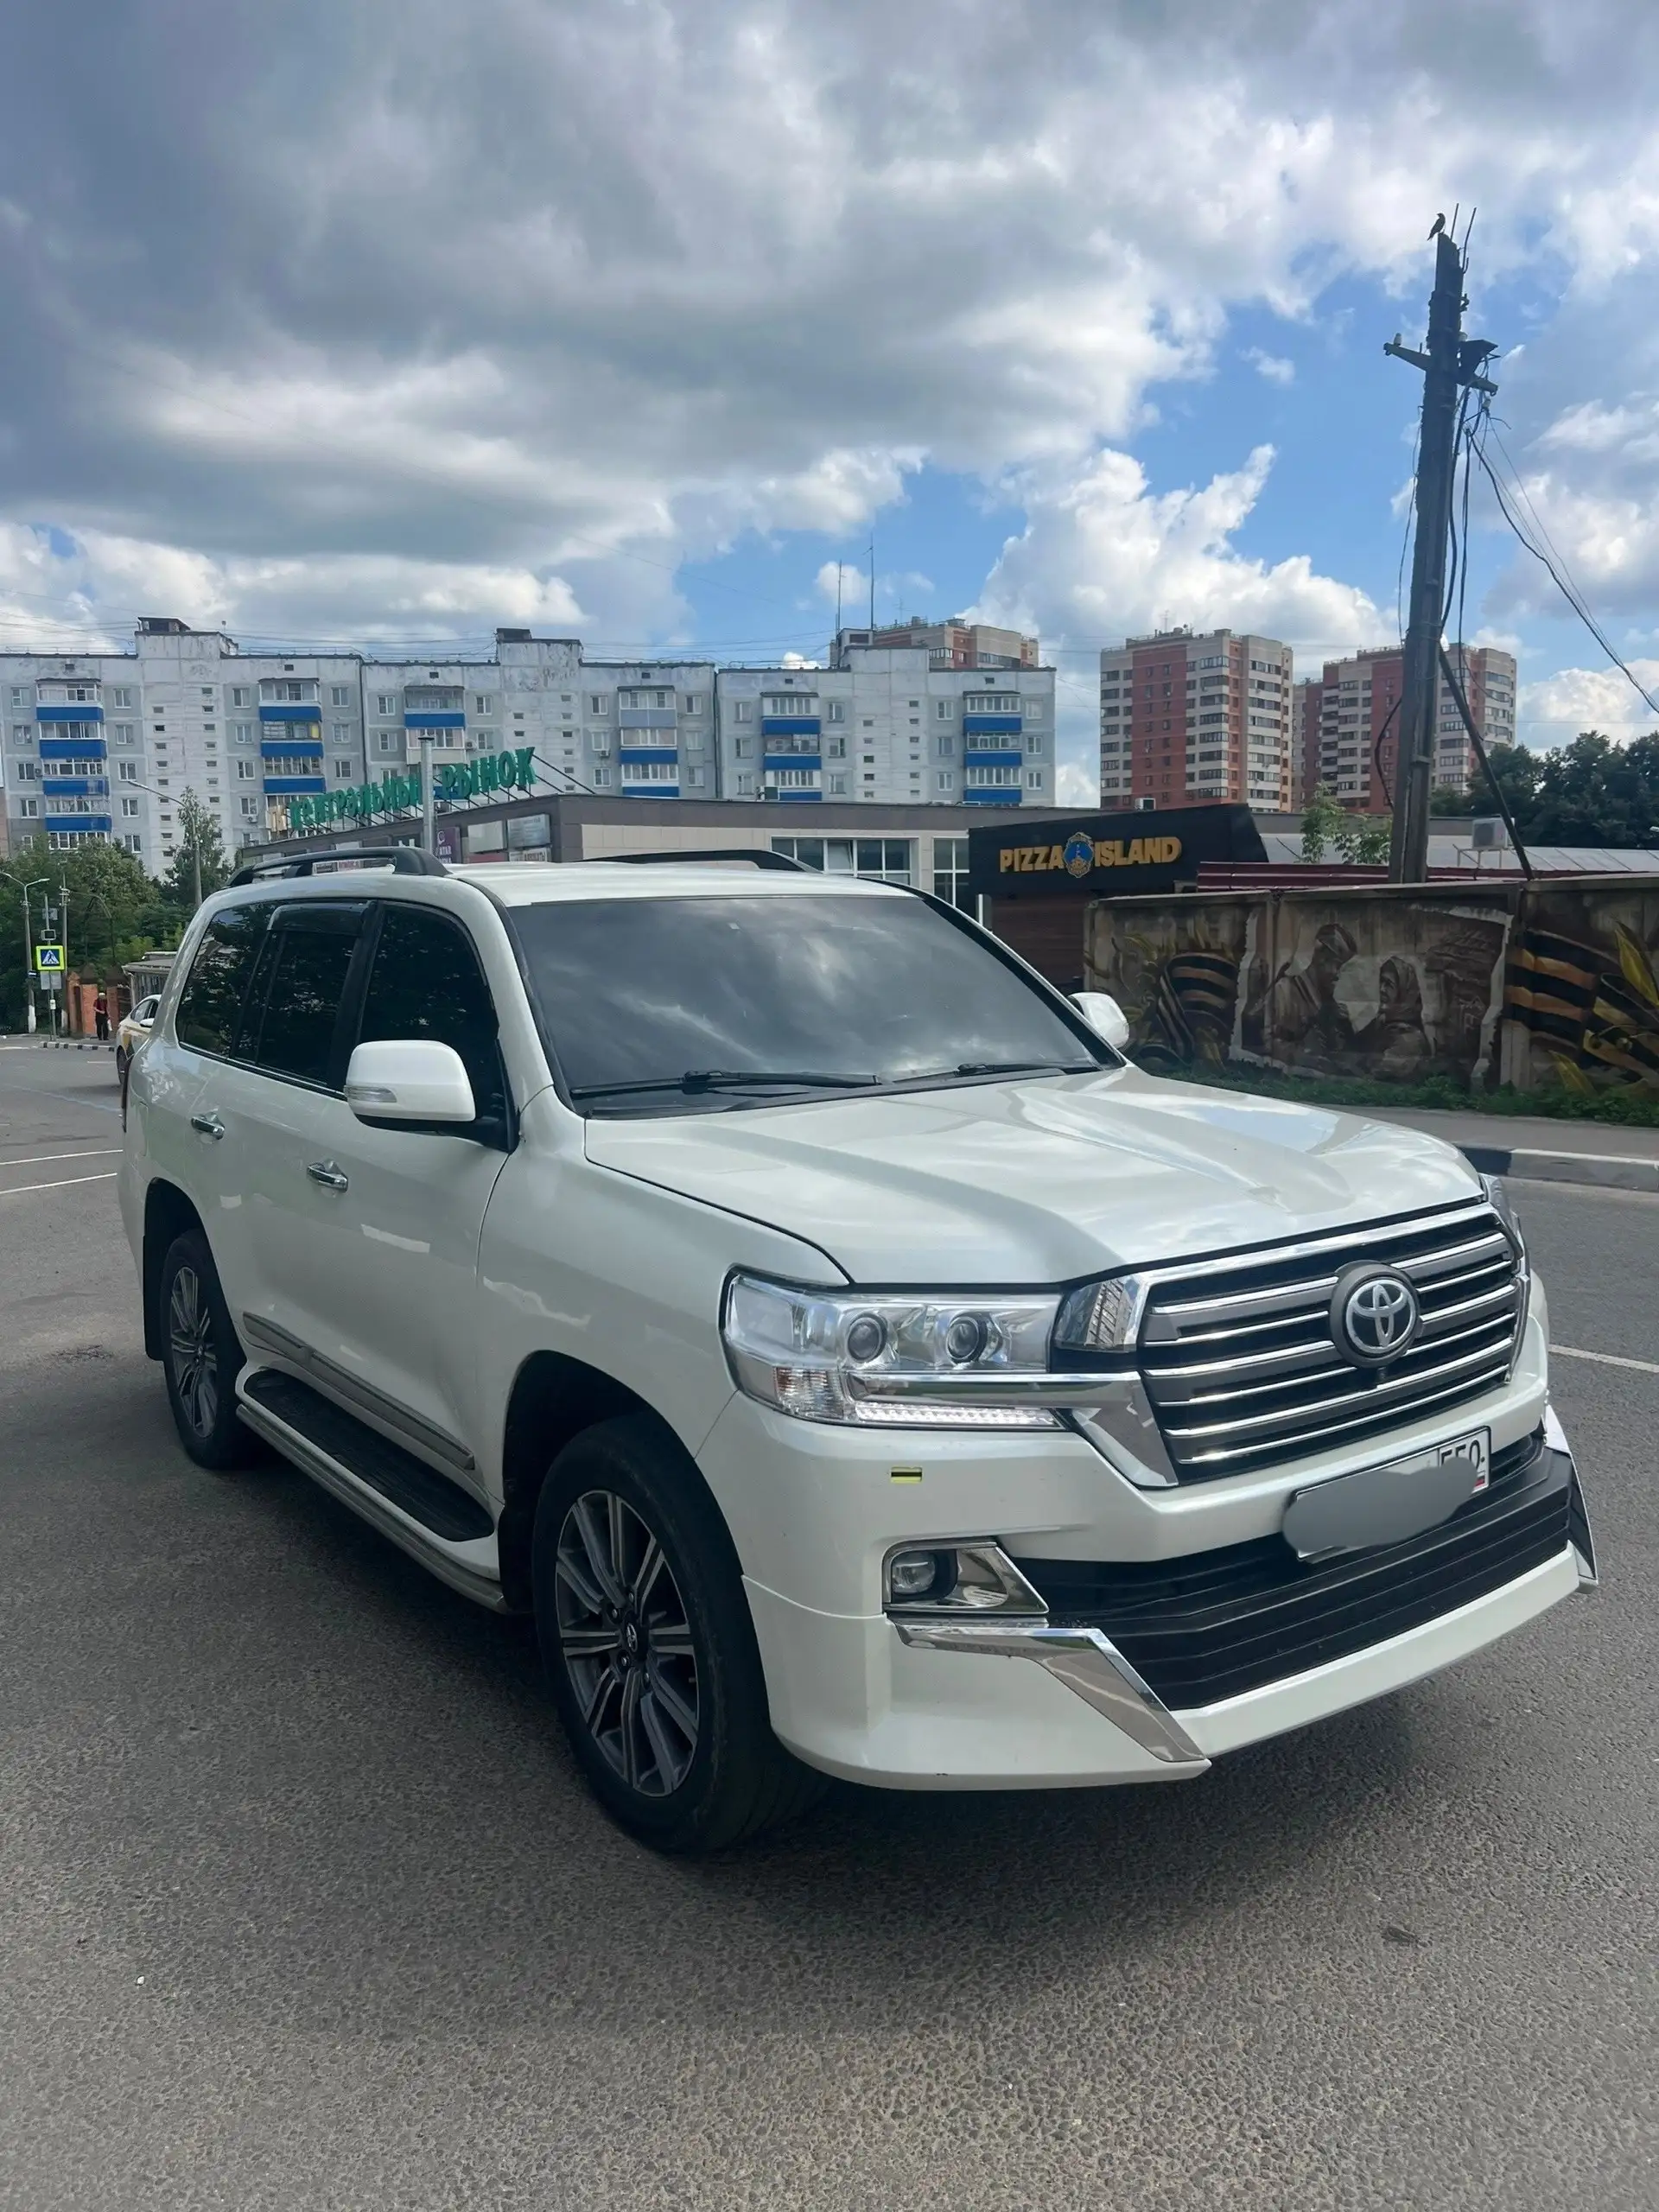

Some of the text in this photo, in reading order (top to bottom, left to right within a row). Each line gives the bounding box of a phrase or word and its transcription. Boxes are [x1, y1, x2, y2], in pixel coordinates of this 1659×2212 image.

[442, 747, 537, 799] РЫНОК
[1000, 836, 1182, 873] PIZZA ISLAND
